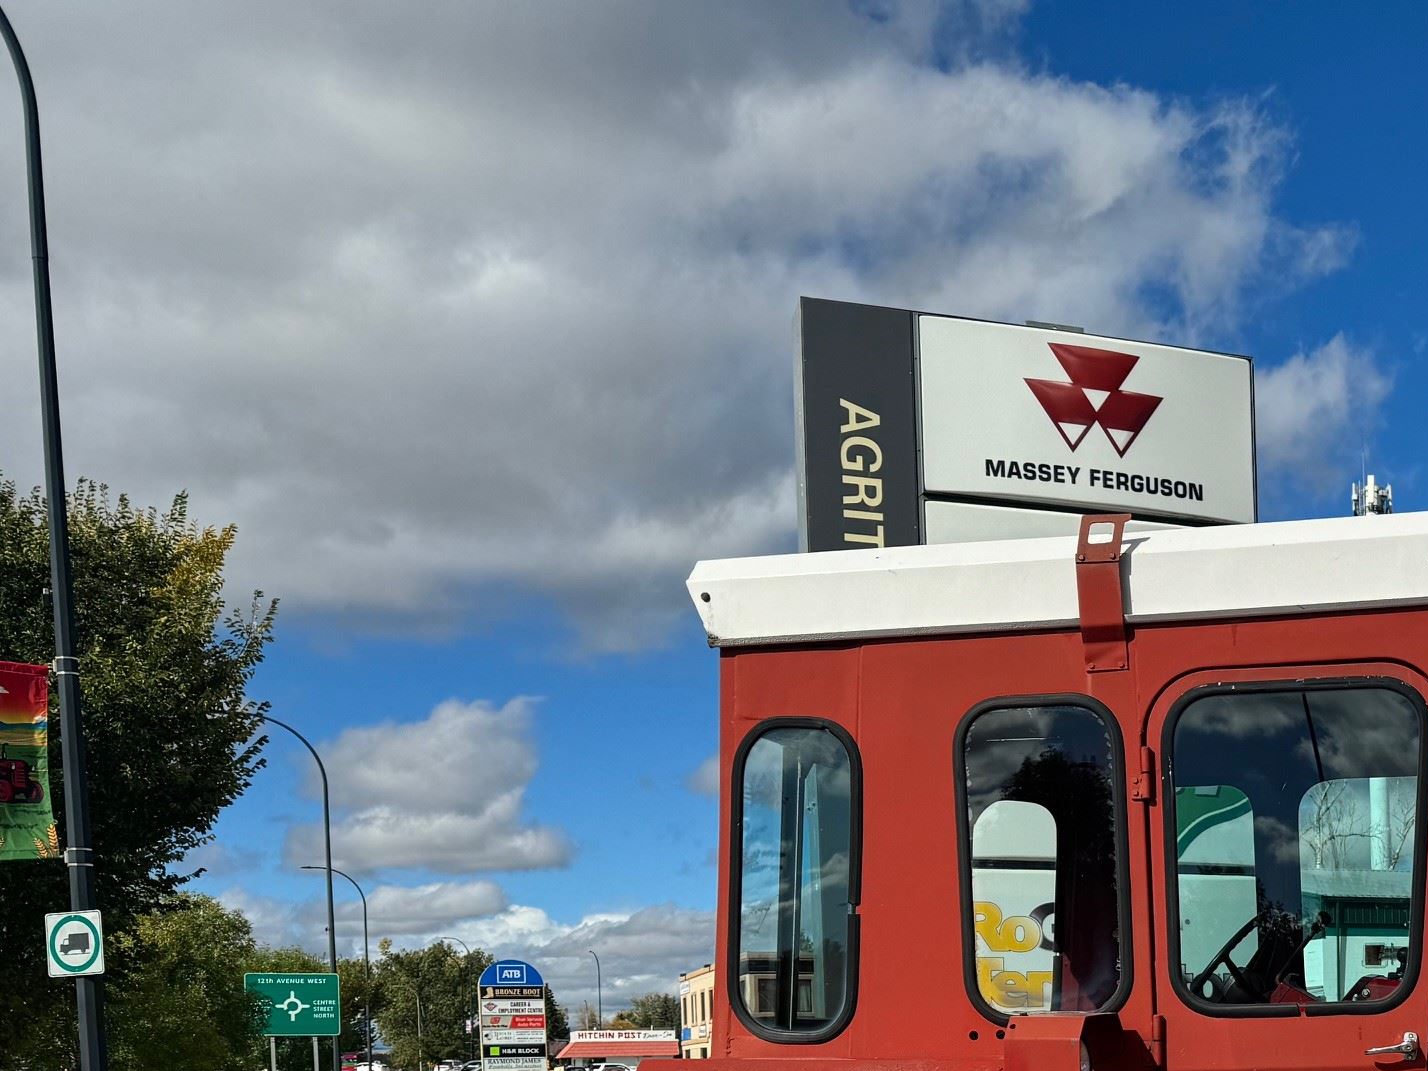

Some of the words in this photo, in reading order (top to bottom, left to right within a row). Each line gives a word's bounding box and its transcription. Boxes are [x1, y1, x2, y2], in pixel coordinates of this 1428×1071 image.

[984, 458, 1081, 485] MASSEY
[1089, 468, 1204, 502] FERGUSON
[501, 969, 521, 979] ATB
[618, 1031, 642, 1039] POST
